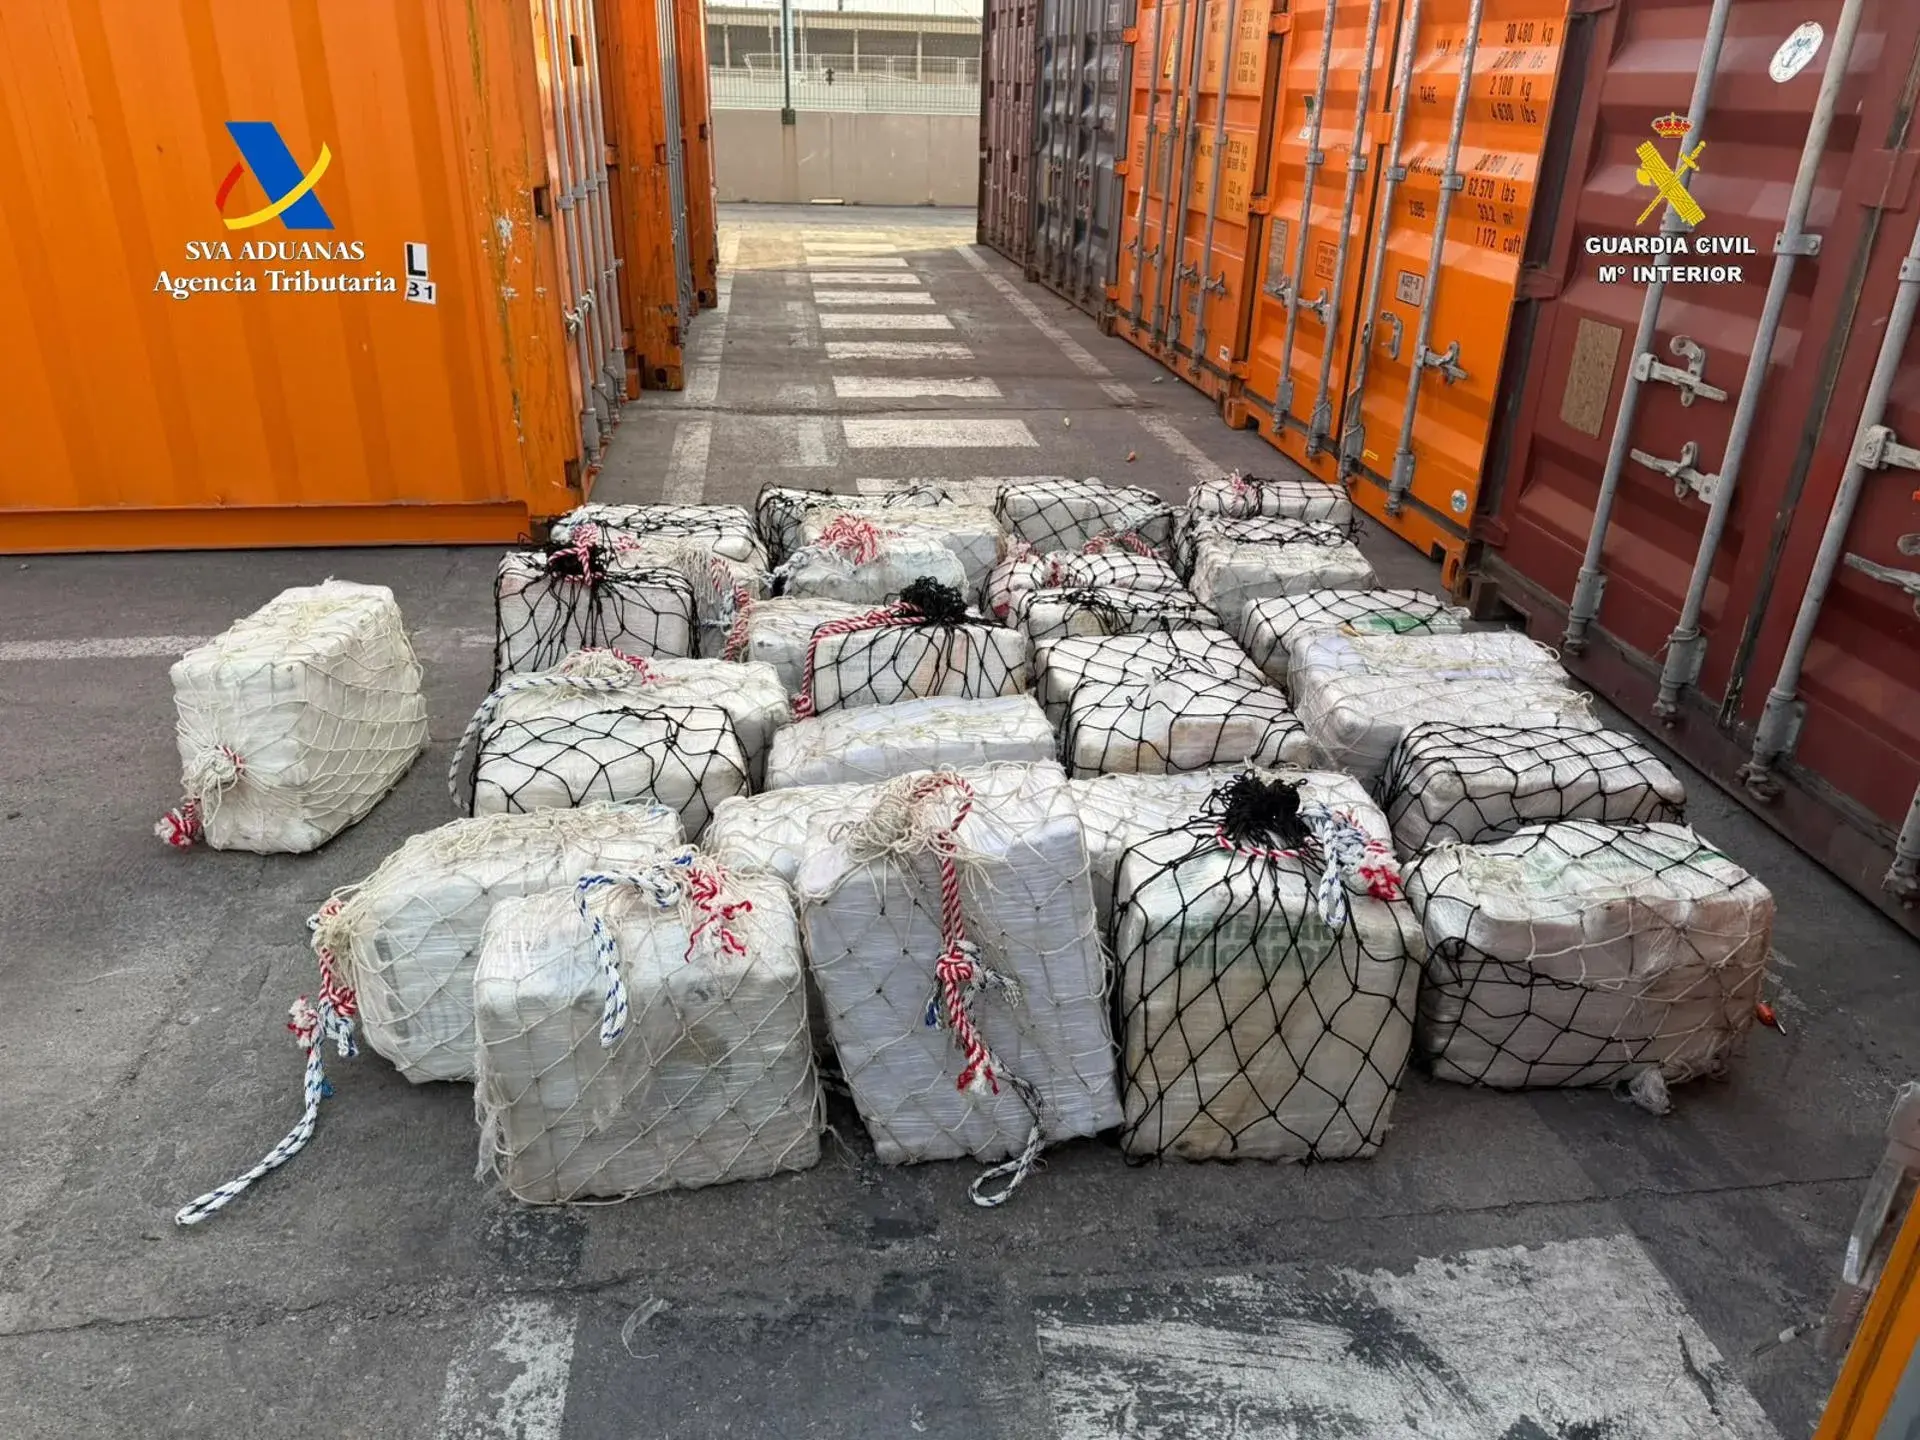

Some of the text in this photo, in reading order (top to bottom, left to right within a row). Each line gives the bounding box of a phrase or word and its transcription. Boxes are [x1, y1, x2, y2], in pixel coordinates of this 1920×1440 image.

[1541, 22, 1554, 47] kg
[1520, 77, 1532, 102] kg
[1520, 104, 1537, 123] lbs
[1501, 182, 1516, 203] lbs
[407, 243, 426, 276] L
